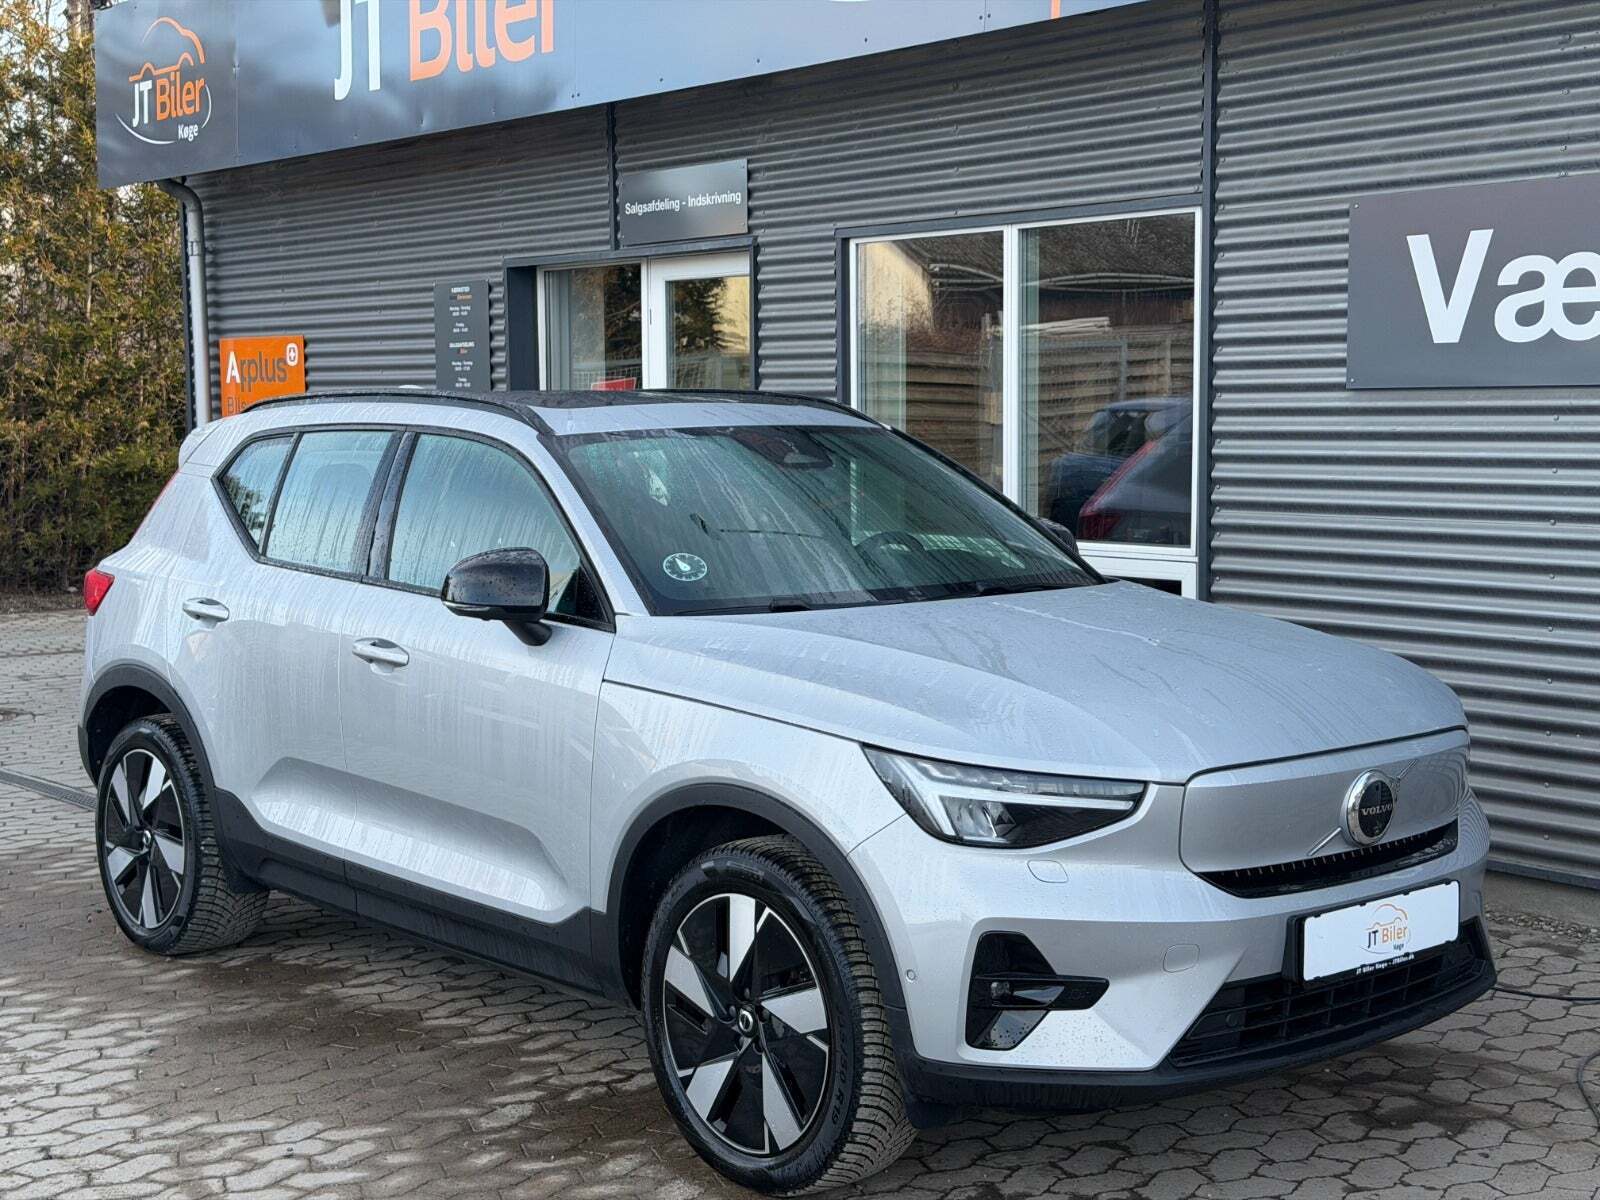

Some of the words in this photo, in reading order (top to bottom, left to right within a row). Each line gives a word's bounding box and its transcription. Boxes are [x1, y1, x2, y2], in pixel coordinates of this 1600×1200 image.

[334, 0, 381, 100] JT
[132, 79, 153, 128] JT
[156, 71, 205, 121] Biler
[177, 123, 199, 142] Køge
[624, 198, 680, 216] Salgsafdeling
[687, 190, 742, 208] Indskrivning
[1406, 228, 1600, 344] Væ
[1361, 803, 1393, 816] VOLVO
[1367, 930, 1379, 949] JT
[1382, 926, 1408, 944] Biler
